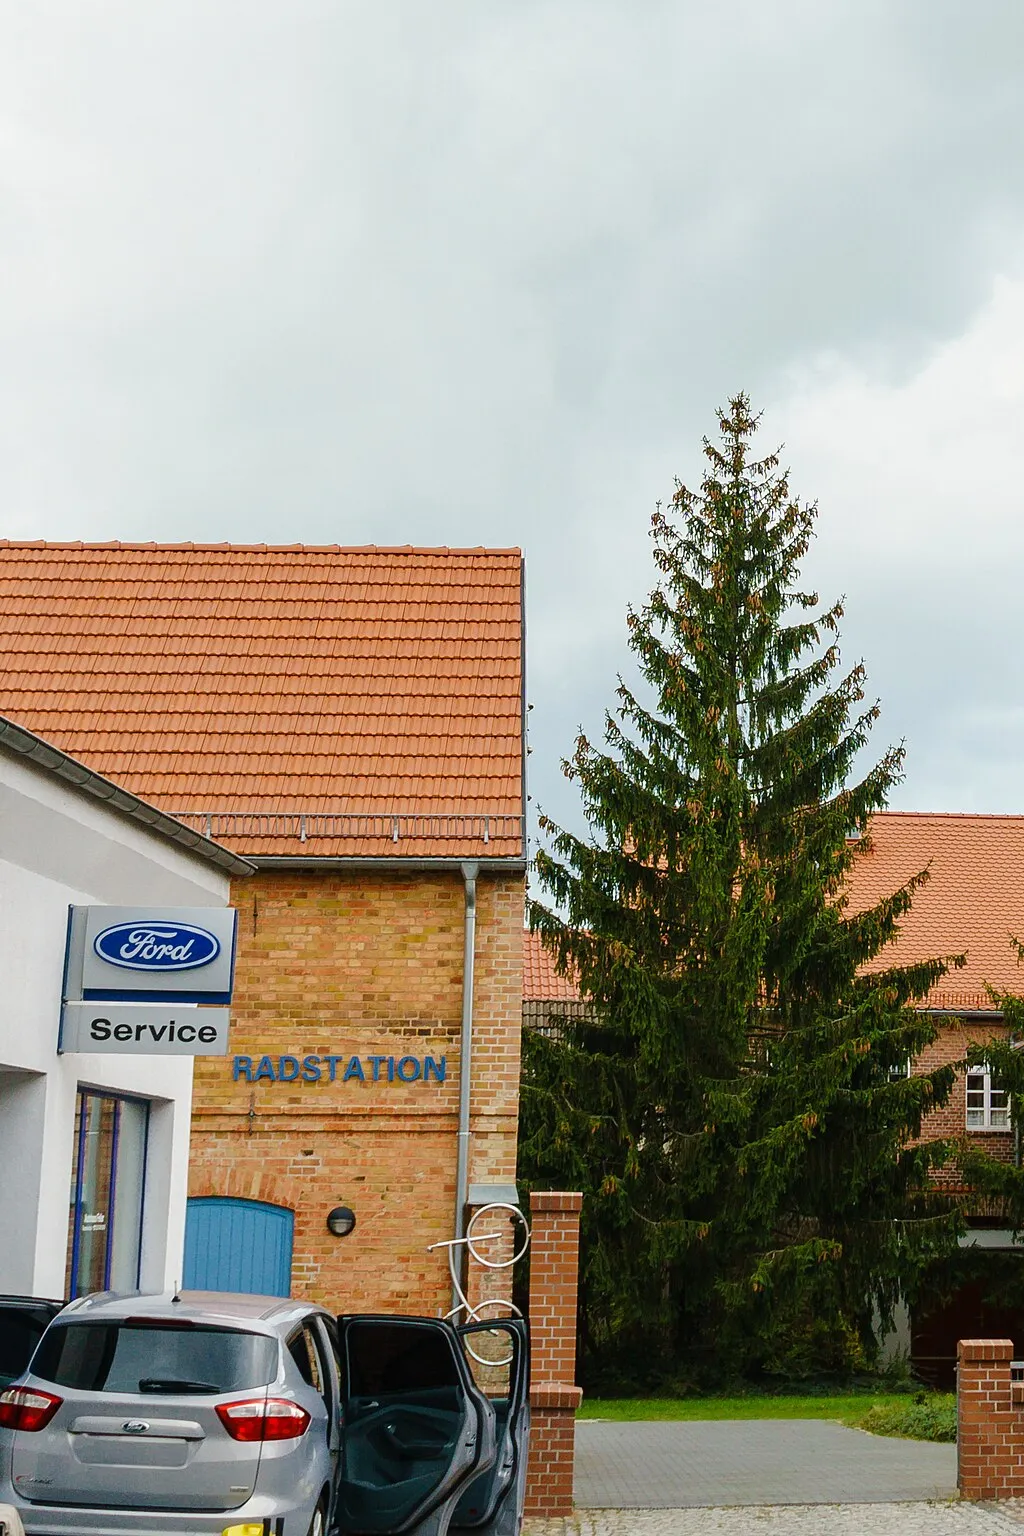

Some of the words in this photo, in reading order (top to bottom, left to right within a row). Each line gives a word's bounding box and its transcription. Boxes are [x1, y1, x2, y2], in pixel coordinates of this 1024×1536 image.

[119, 929, 195, 961] Ford
[90, 1018, 218, 1043] Service
[231, 1055, 446, 1083] RADSTATION
